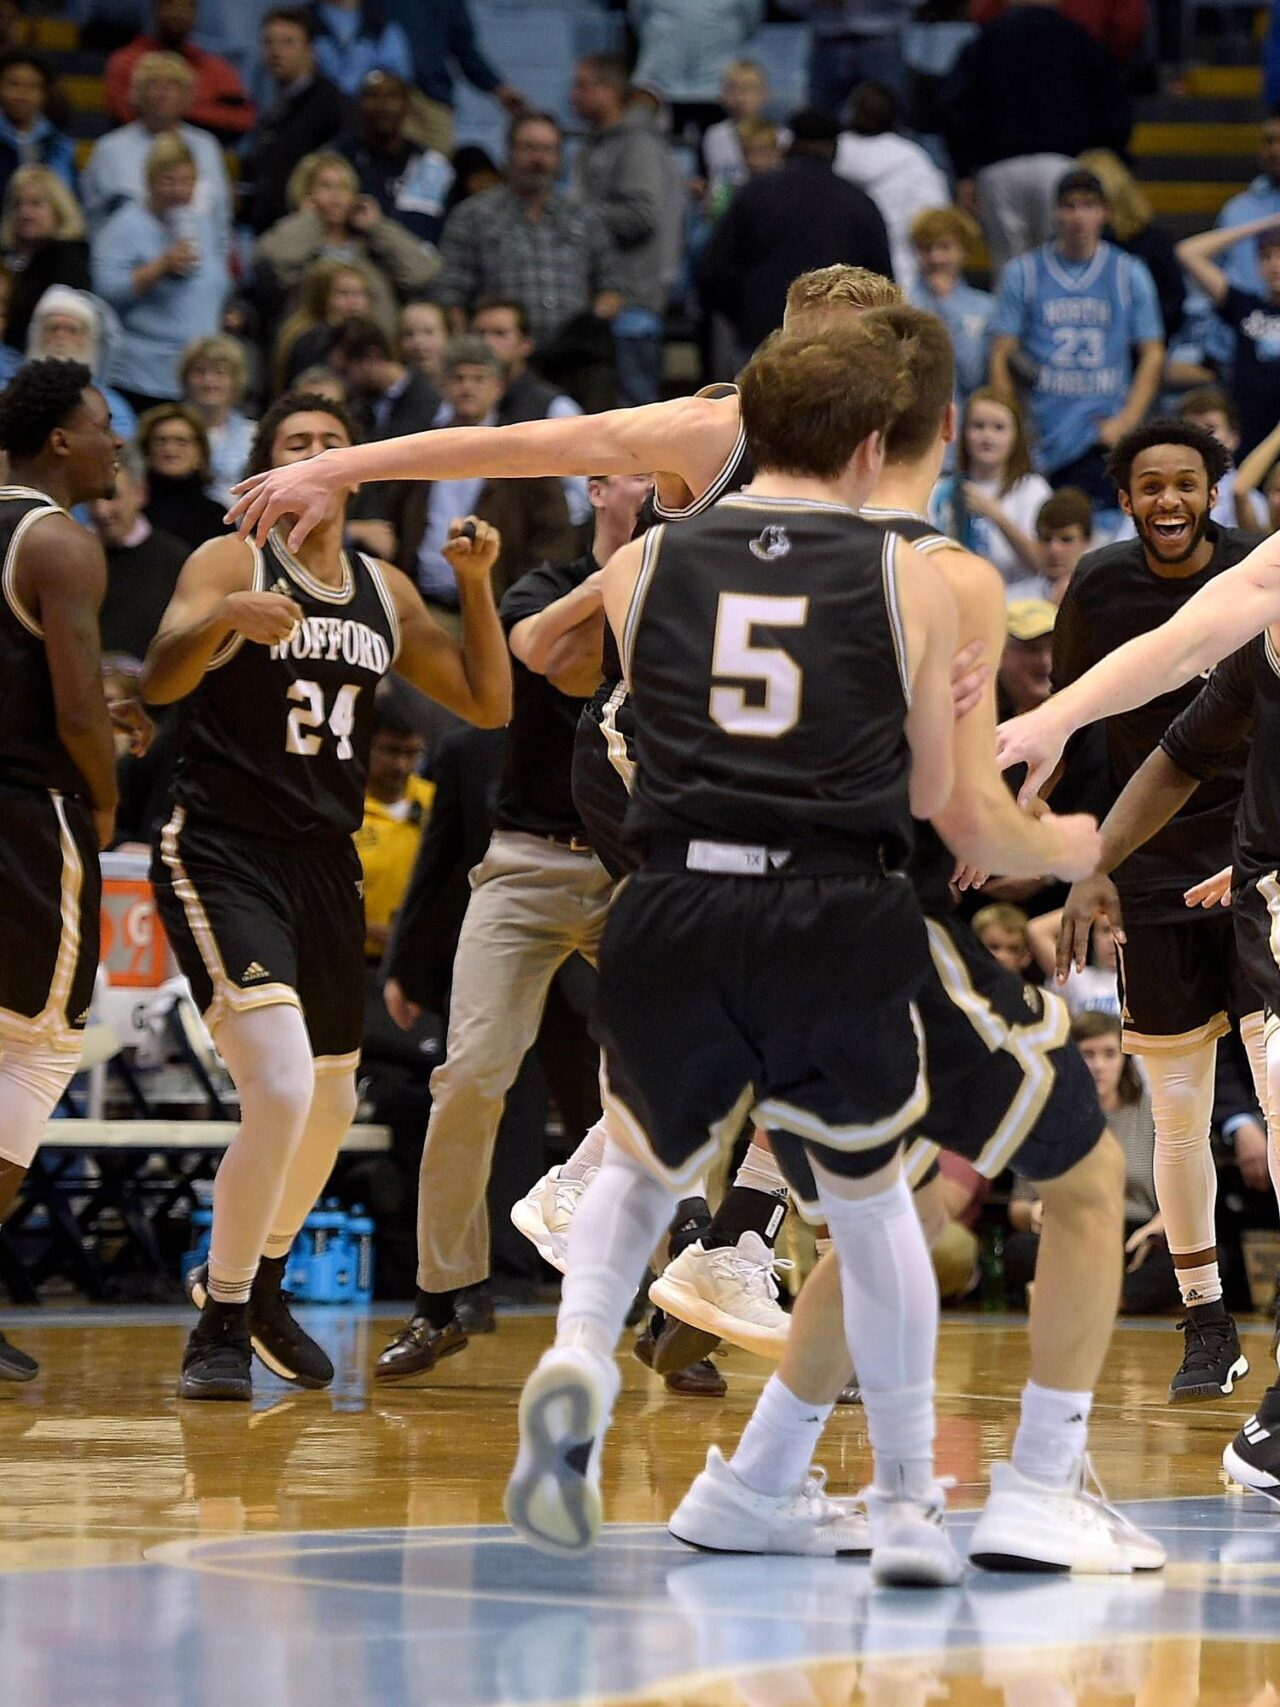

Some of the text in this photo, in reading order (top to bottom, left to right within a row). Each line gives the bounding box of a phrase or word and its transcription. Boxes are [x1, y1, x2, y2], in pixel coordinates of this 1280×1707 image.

[1051, 328, 1105, 367] 23
[708, 591, 810, 739] 5
[285, 678, 362, 760] 24
